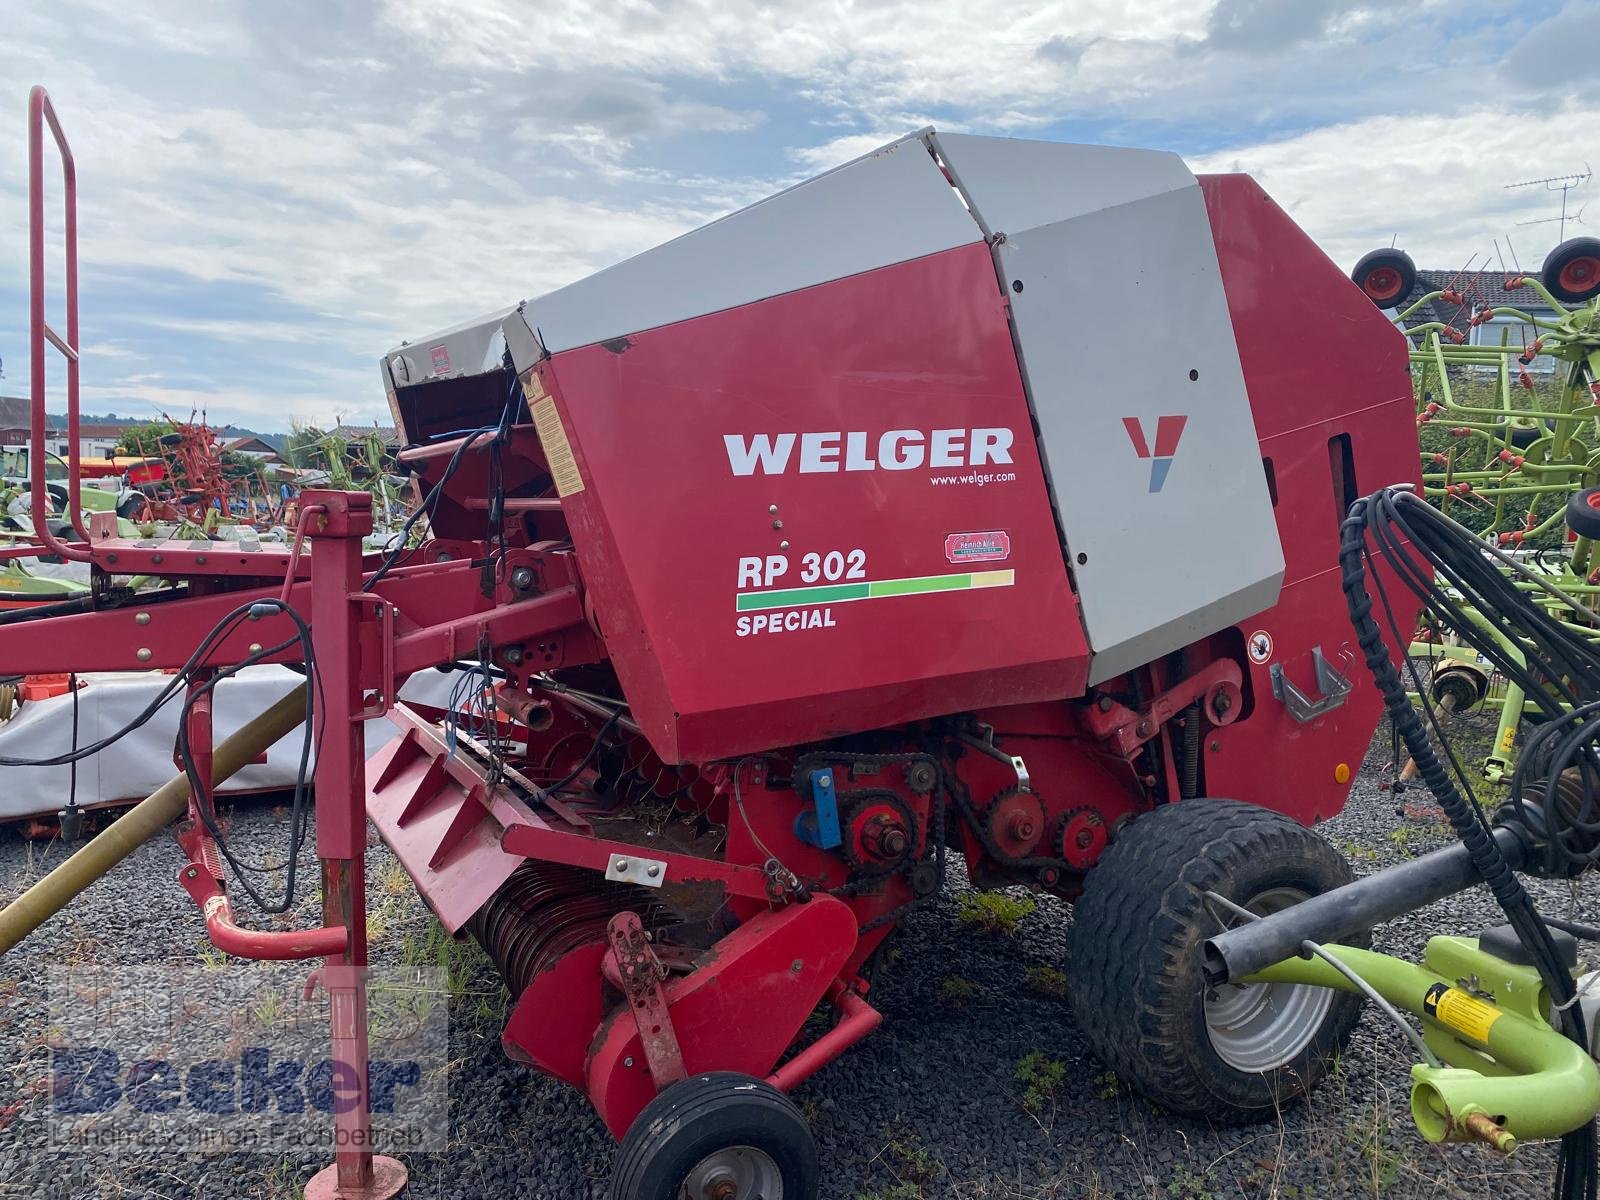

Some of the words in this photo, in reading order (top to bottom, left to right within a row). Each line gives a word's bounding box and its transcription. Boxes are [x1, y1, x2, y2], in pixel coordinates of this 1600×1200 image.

[723, 428, 1014, 476] WELGER
[931, 471, 1016, 486] www.welger.com
[738, 555, 788, 588] RP
[801, 549, 866, 583] 302
[736, 608, 836, 637] SPECIAL
